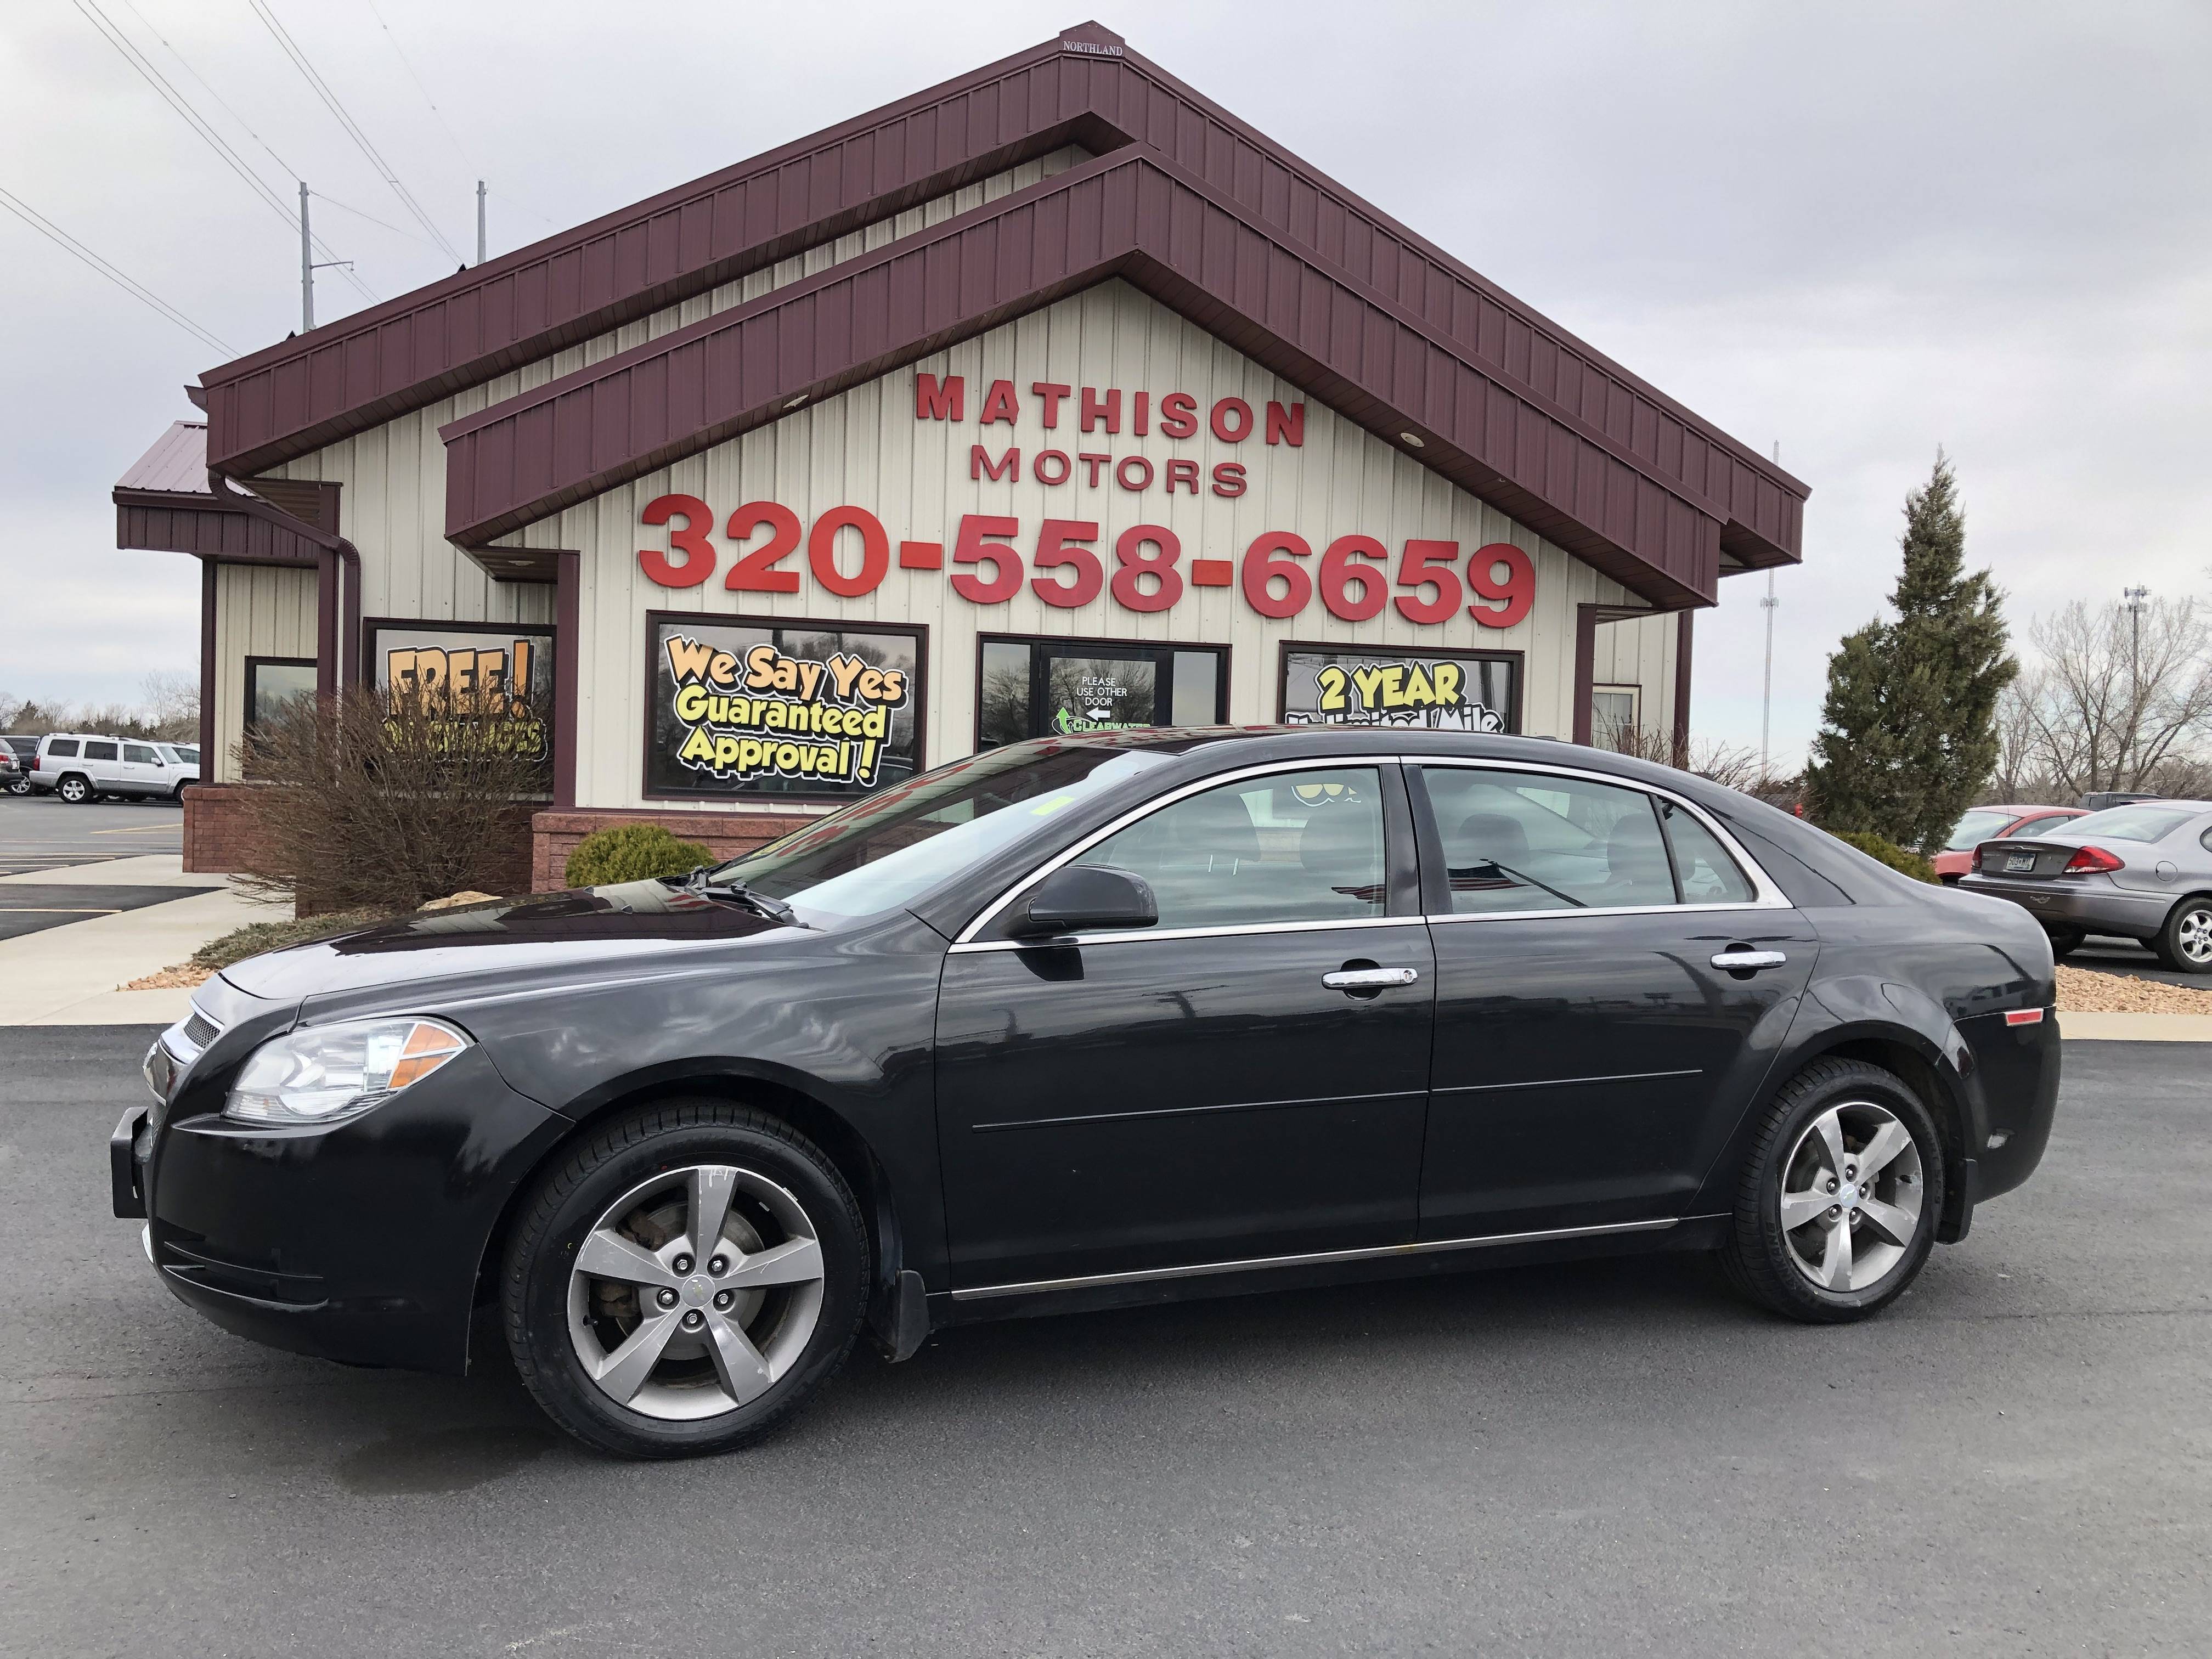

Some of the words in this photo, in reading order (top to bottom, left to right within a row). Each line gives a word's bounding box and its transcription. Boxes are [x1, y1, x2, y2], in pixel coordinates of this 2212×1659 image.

[1063, 41, 1123, 56] NORTHLAND
[916, 373, 1305, 447] MATHISON
[970, 444, 1247, 498] MOTORS
[639, 494, 1536, 629] 320-558-6659
[665, 635, 740, 686] We
[744, 644, 823, 702] Say
[827, 653, 906, 703] Yes
[1076, 687, 1094, 696] USE
[1097, 687, 1127, 697] OTHER
[1082, 676, 1116, 686] PLEASE
[1316, 665, 1347, 712] 2
[1350, 660, 1464, 709] YEAR
[675, 683, 890, 741] Guaranteed
[1085, 697, 1113, 707] DOOR
